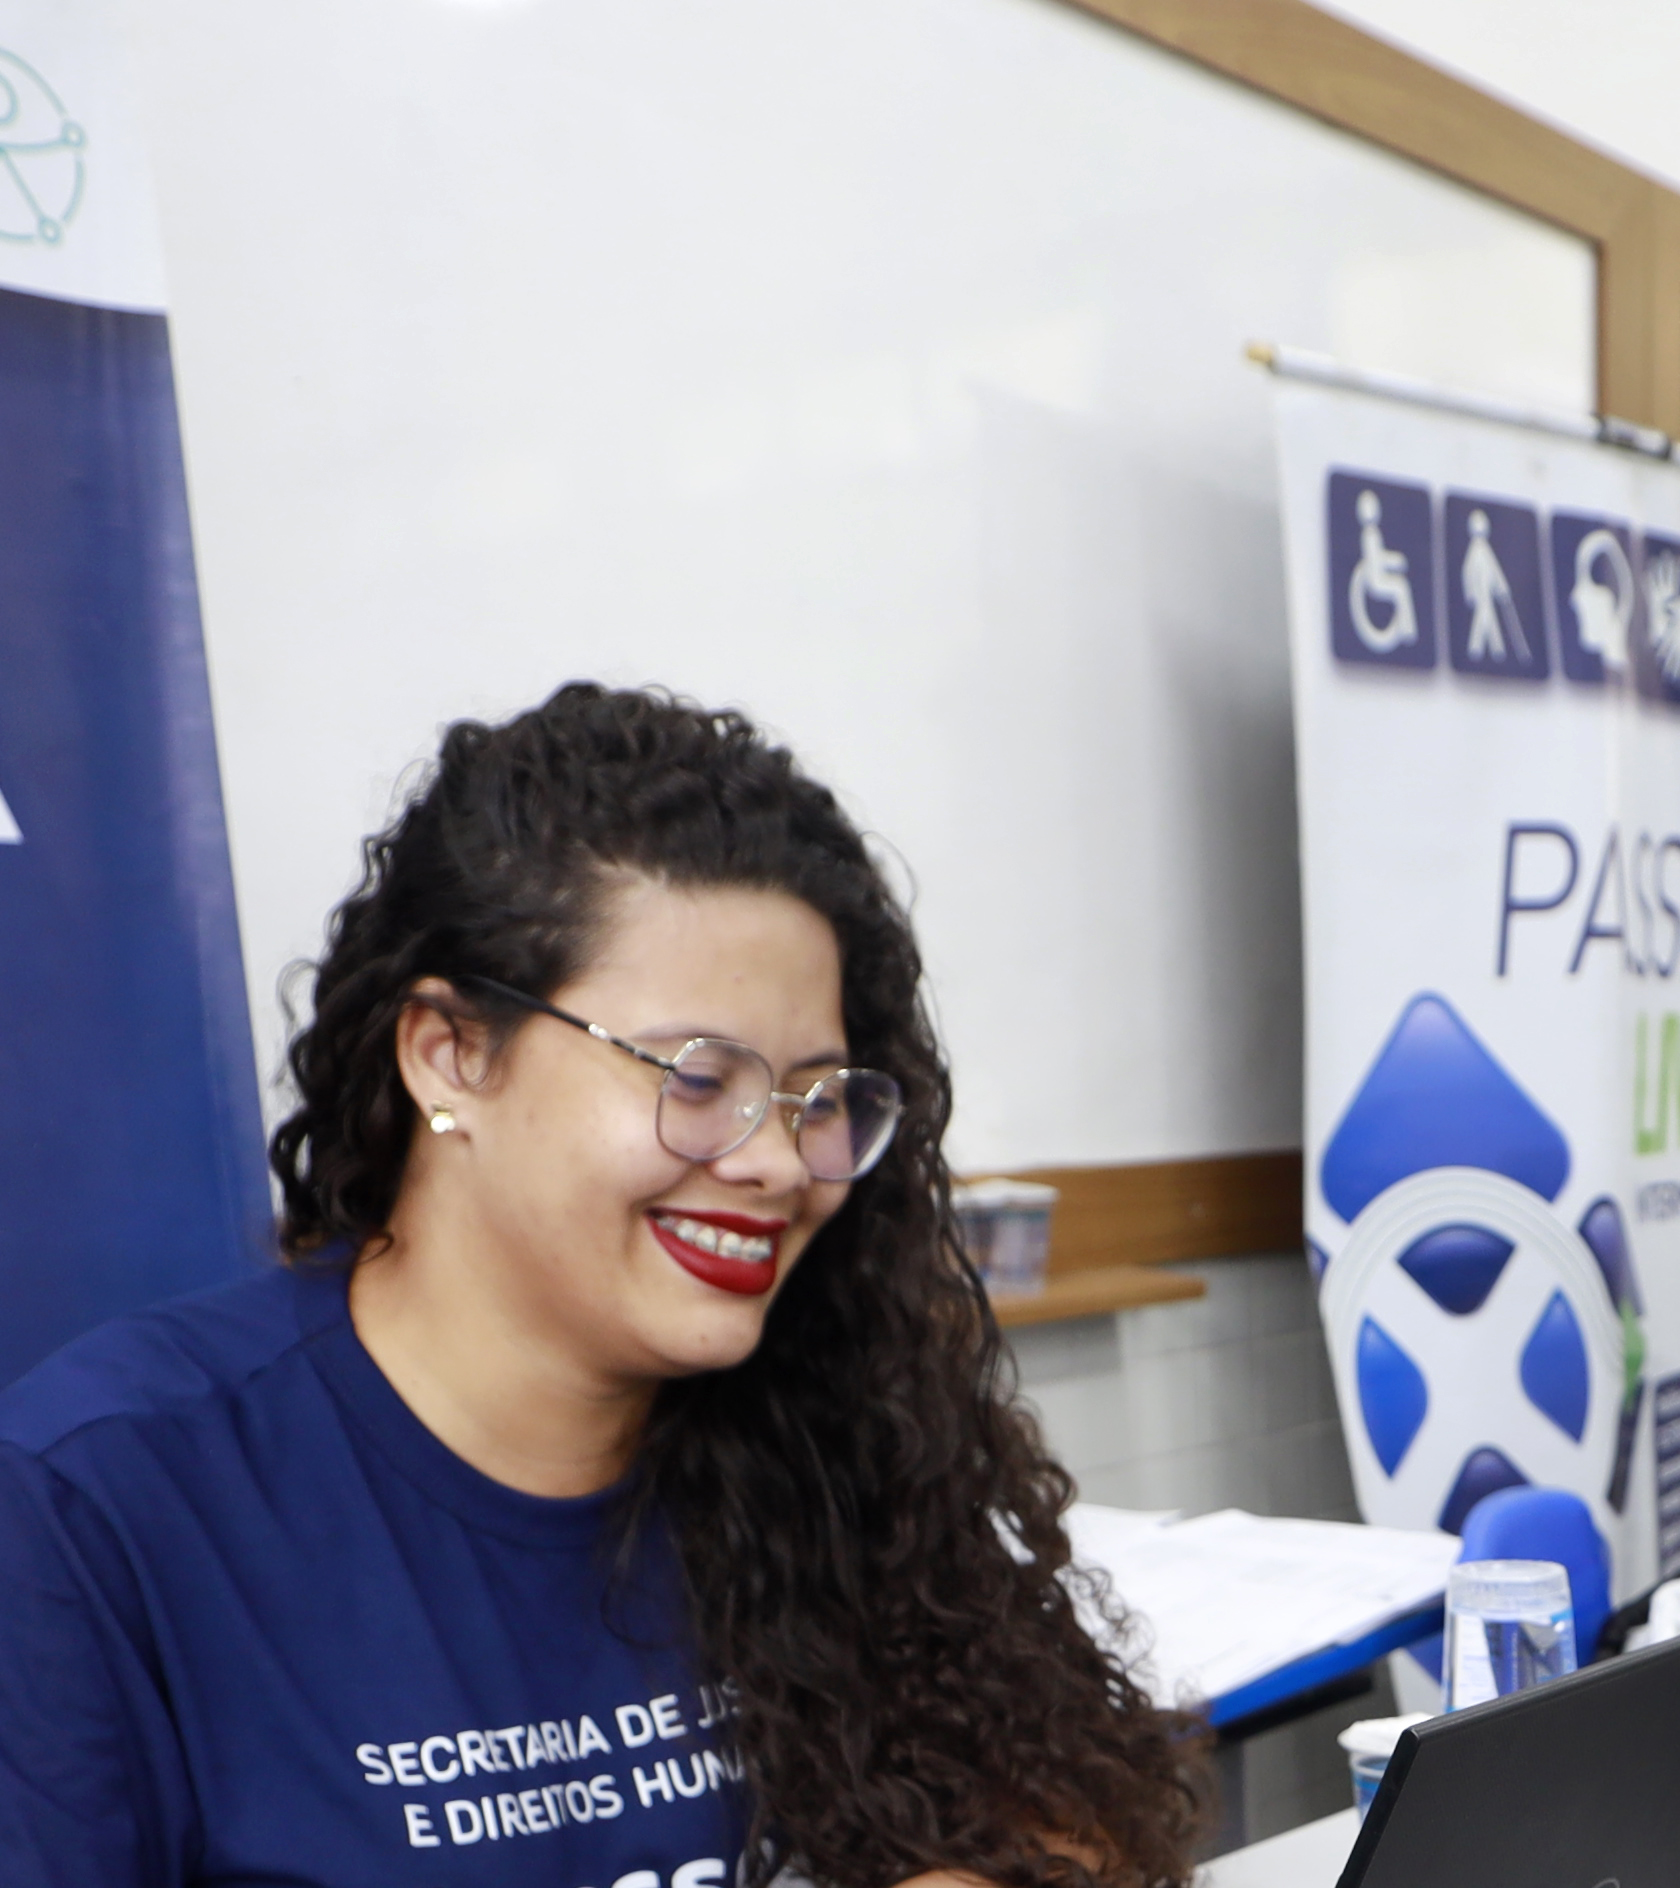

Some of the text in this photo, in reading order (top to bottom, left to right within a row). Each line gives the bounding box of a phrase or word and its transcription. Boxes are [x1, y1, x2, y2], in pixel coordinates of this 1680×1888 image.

[356, 1714, 612, 1786] SECRETARIA
[614, 1693, 688, 1748] DE
[404, 1804, 441, 1848] E
[444, 1775, 623, 1845] DIREITOS
